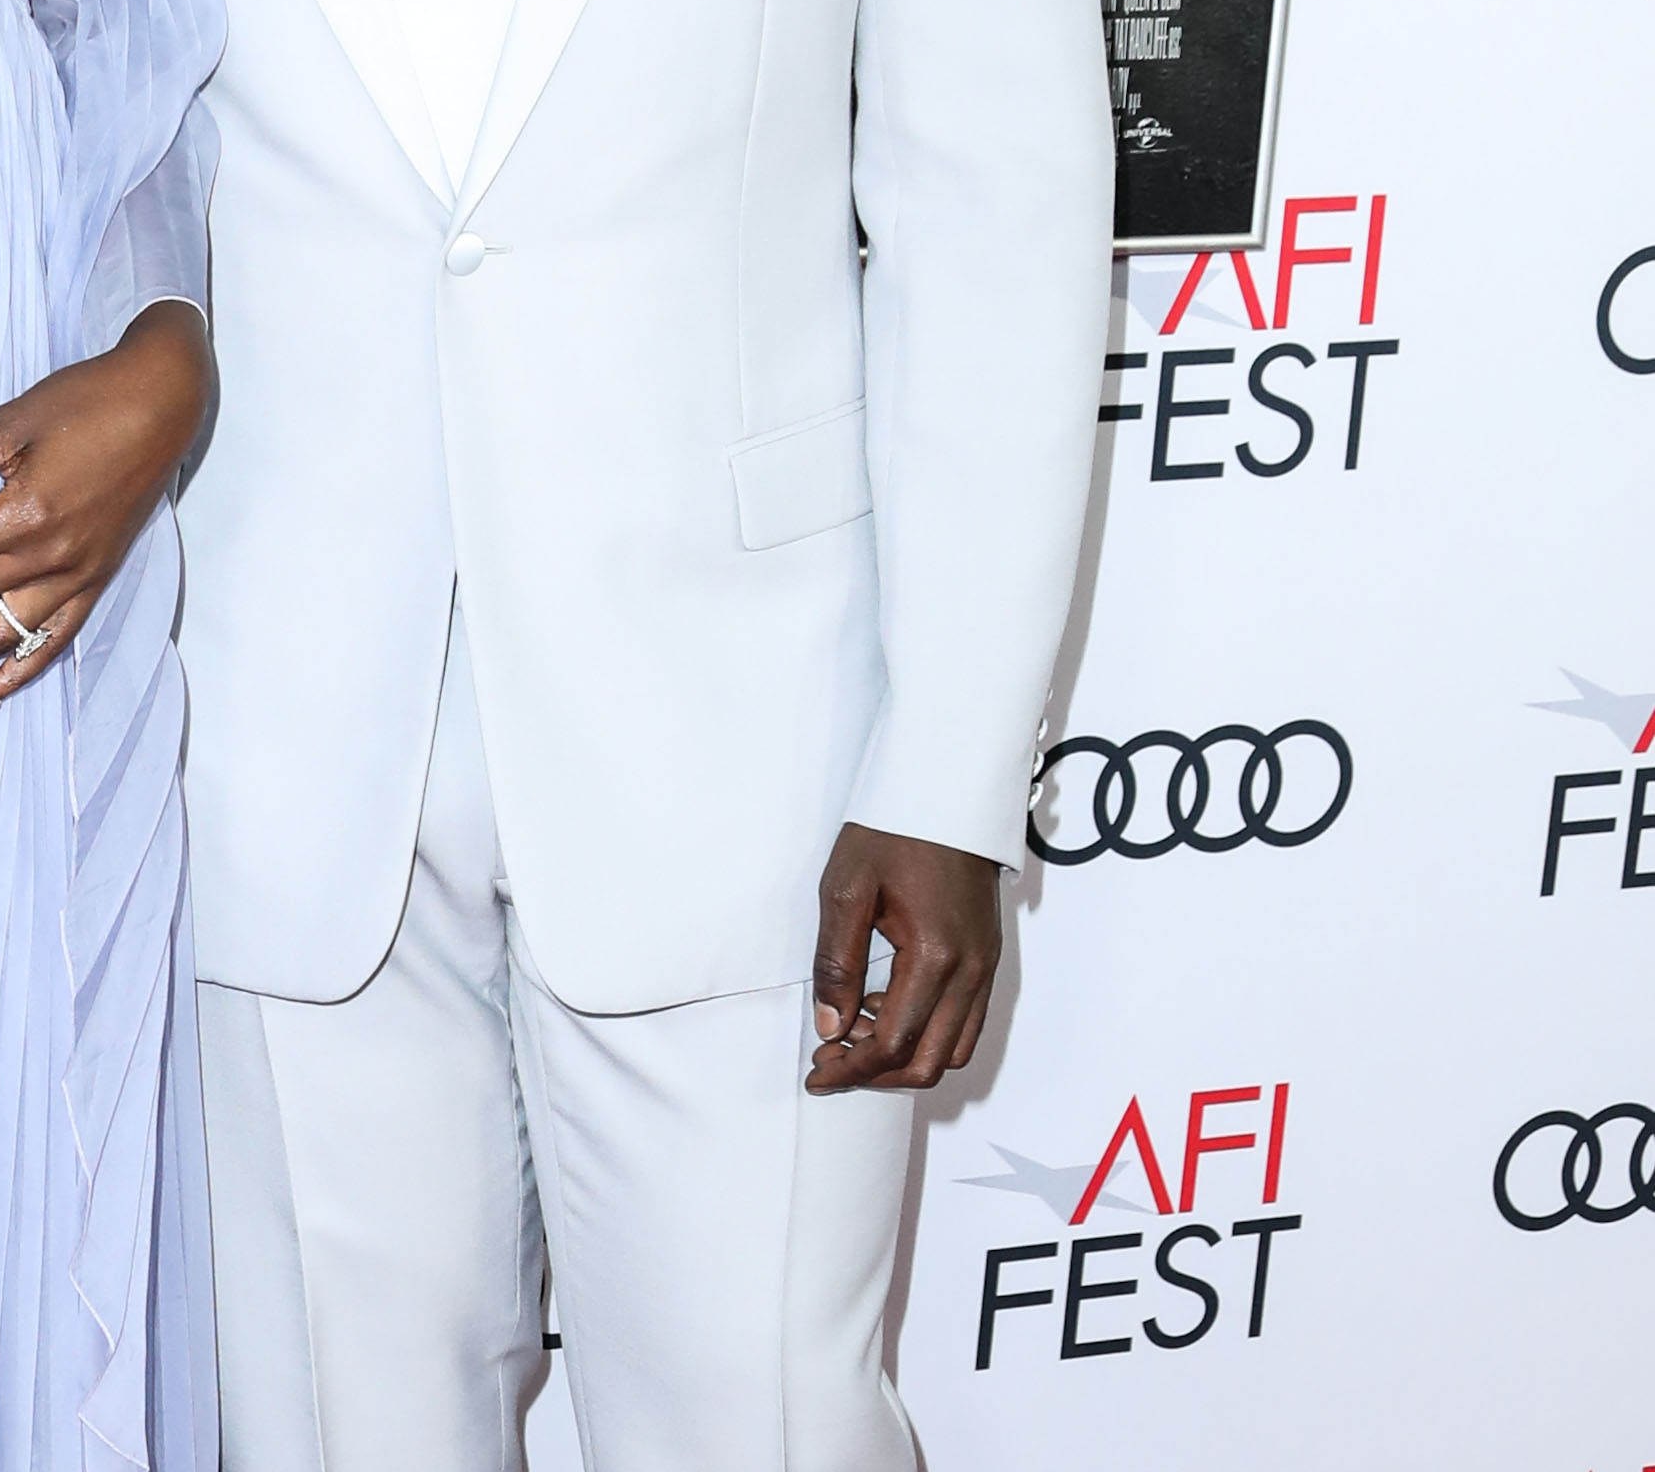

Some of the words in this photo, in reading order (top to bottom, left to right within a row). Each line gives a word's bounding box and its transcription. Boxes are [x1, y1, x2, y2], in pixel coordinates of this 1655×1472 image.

[1123, 128, 1173, 139] UNIVERSAL
[1158, 195, 1387, 336] AFI
[1540, 767, 1655, 897] FE
[1068, 1082, 1290, 1225] AFI
[974, 1214, 1302, 1371] FEST
